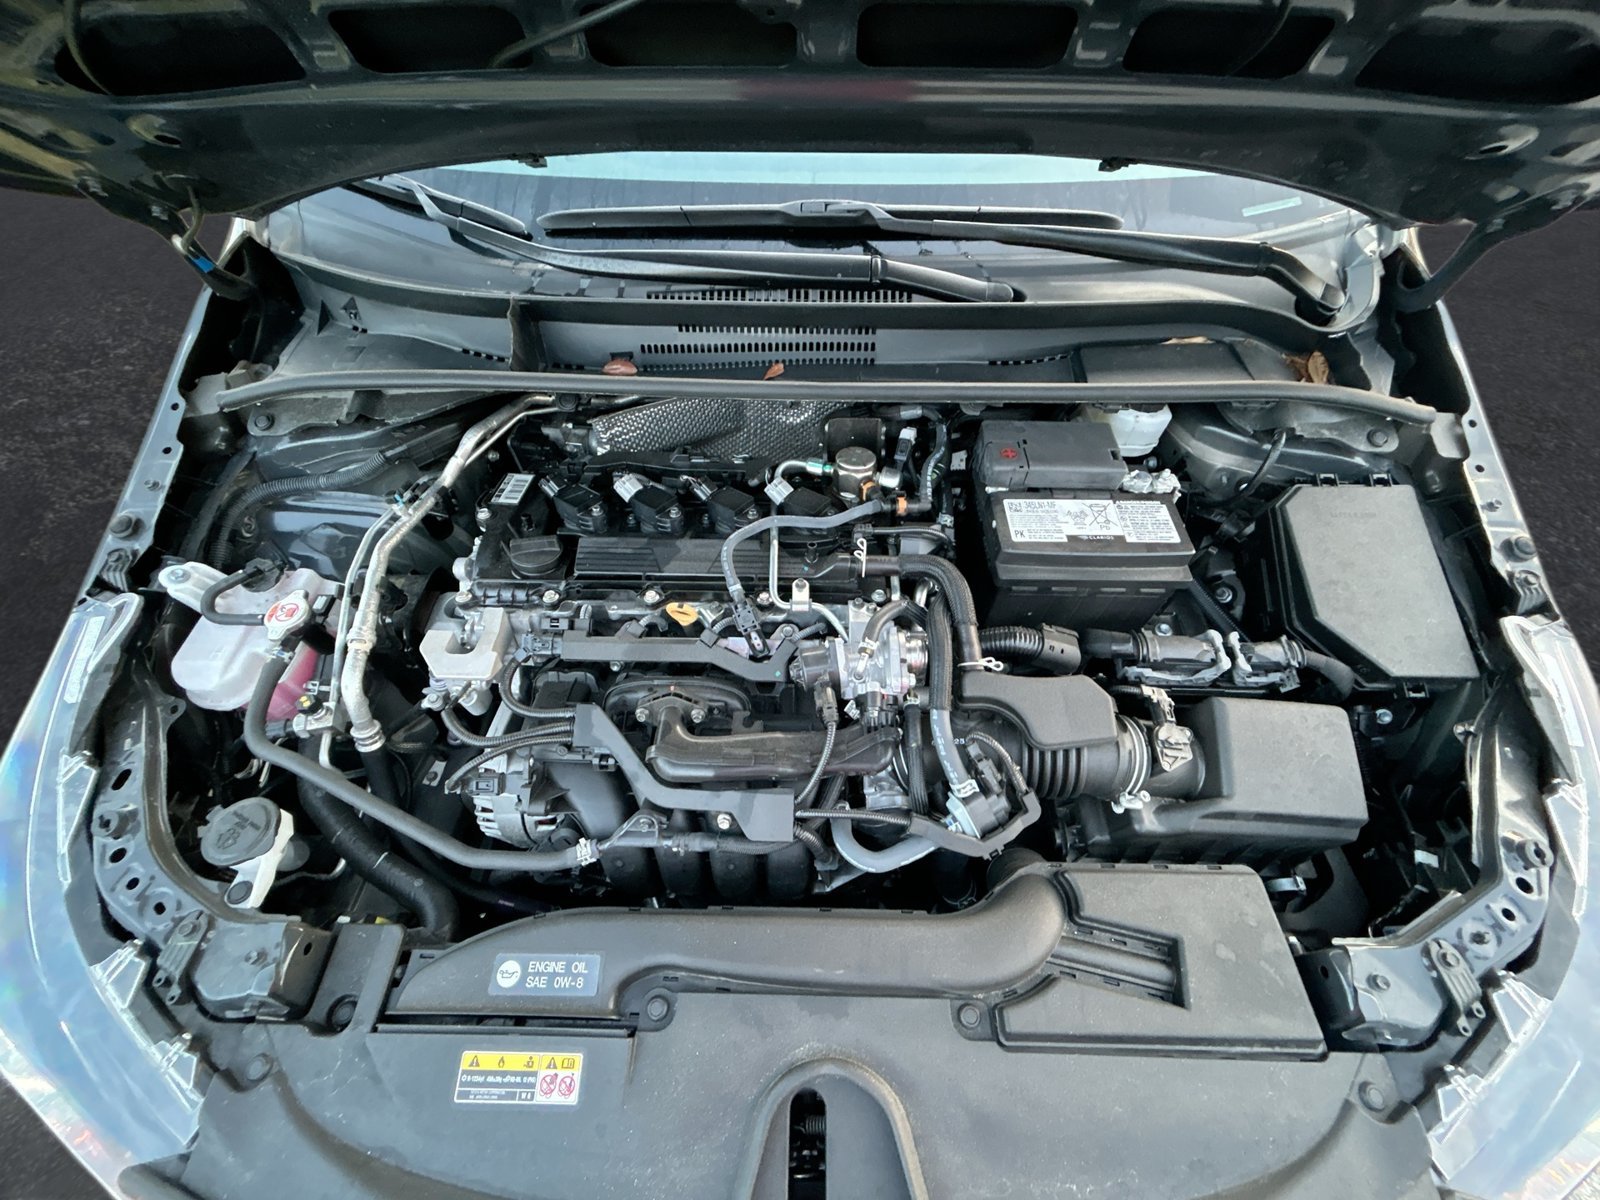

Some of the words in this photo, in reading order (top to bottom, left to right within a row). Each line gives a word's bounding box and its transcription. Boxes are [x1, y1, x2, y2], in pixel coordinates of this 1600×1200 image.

[1014, 530, 1026, 538] PK
[528, 961, 566, 973] ENGINE
[571, 962, 588, 974] OIL
[525, 976, 548, 988] SAE
[553, 976, 584, 989] 0W-8
